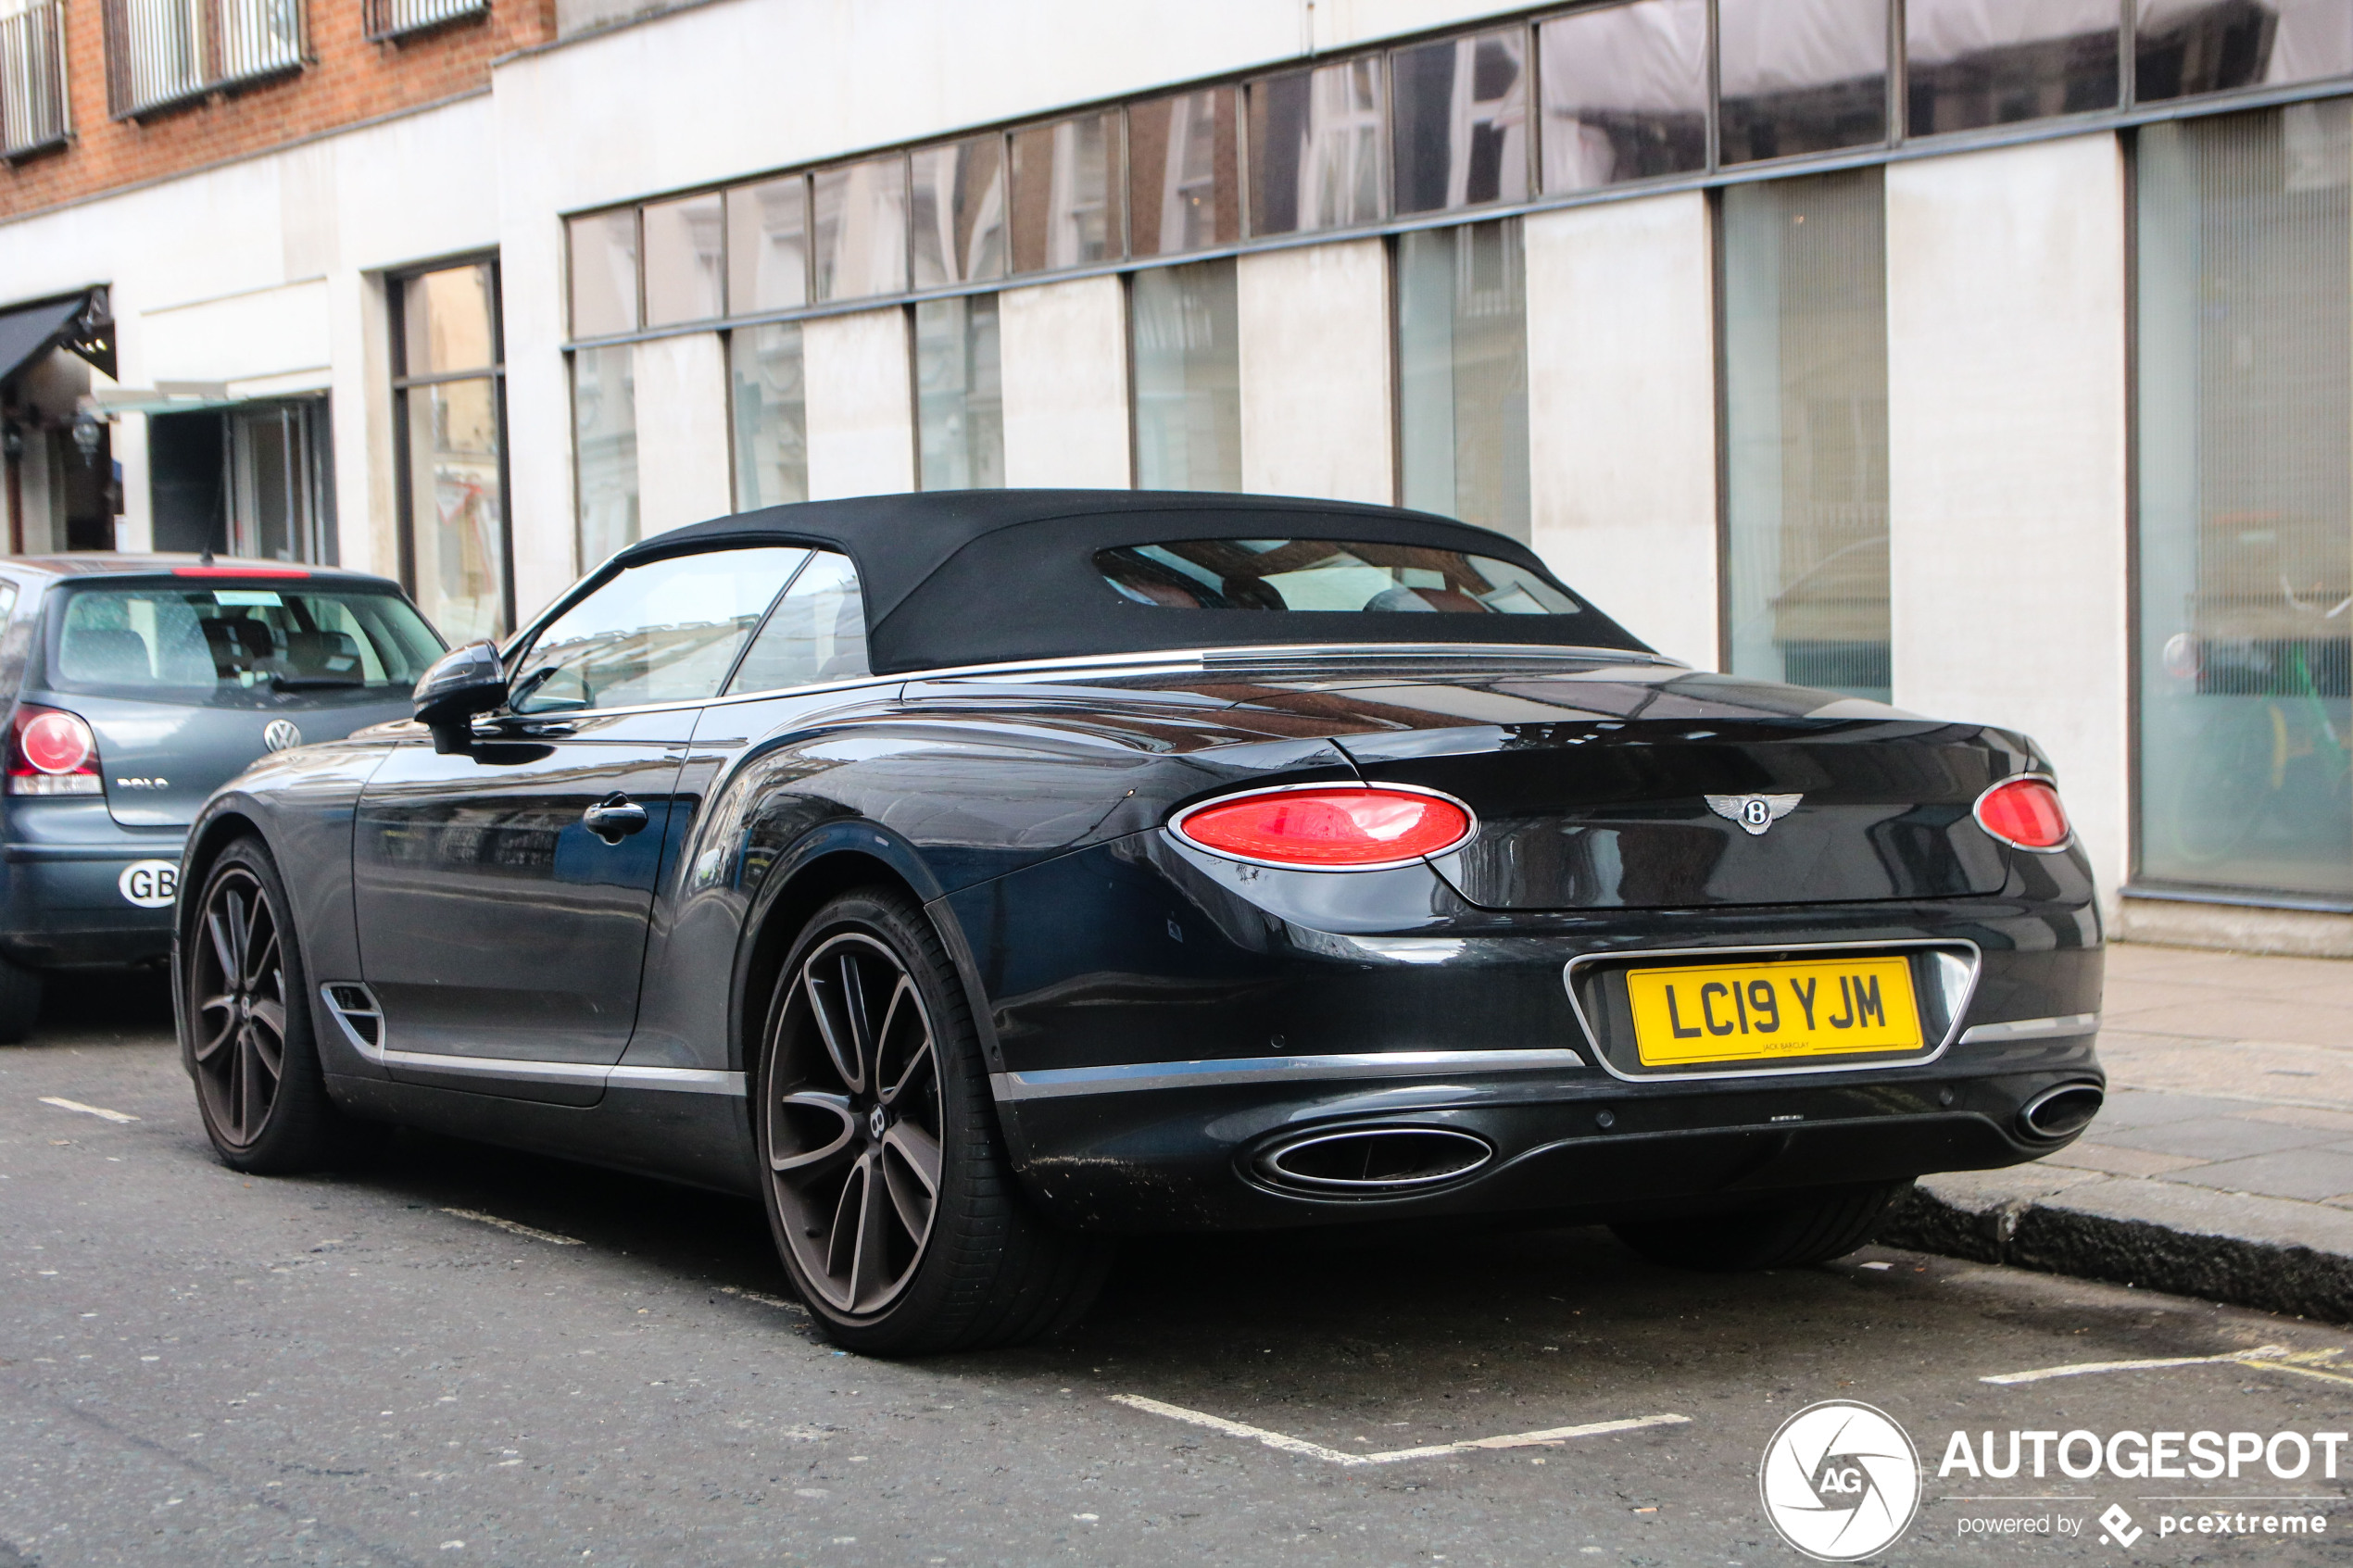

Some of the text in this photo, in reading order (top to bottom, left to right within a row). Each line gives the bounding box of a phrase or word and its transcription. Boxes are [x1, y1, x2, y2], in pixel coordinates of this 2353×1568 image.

[130, 870, 178, 898] GB
[1665, 973, 1886, 1039] LC19 YJM
[1763, 1043, 1779, 1052] JACK
[1780, 1042, 1809, 1050] BARCLAY
